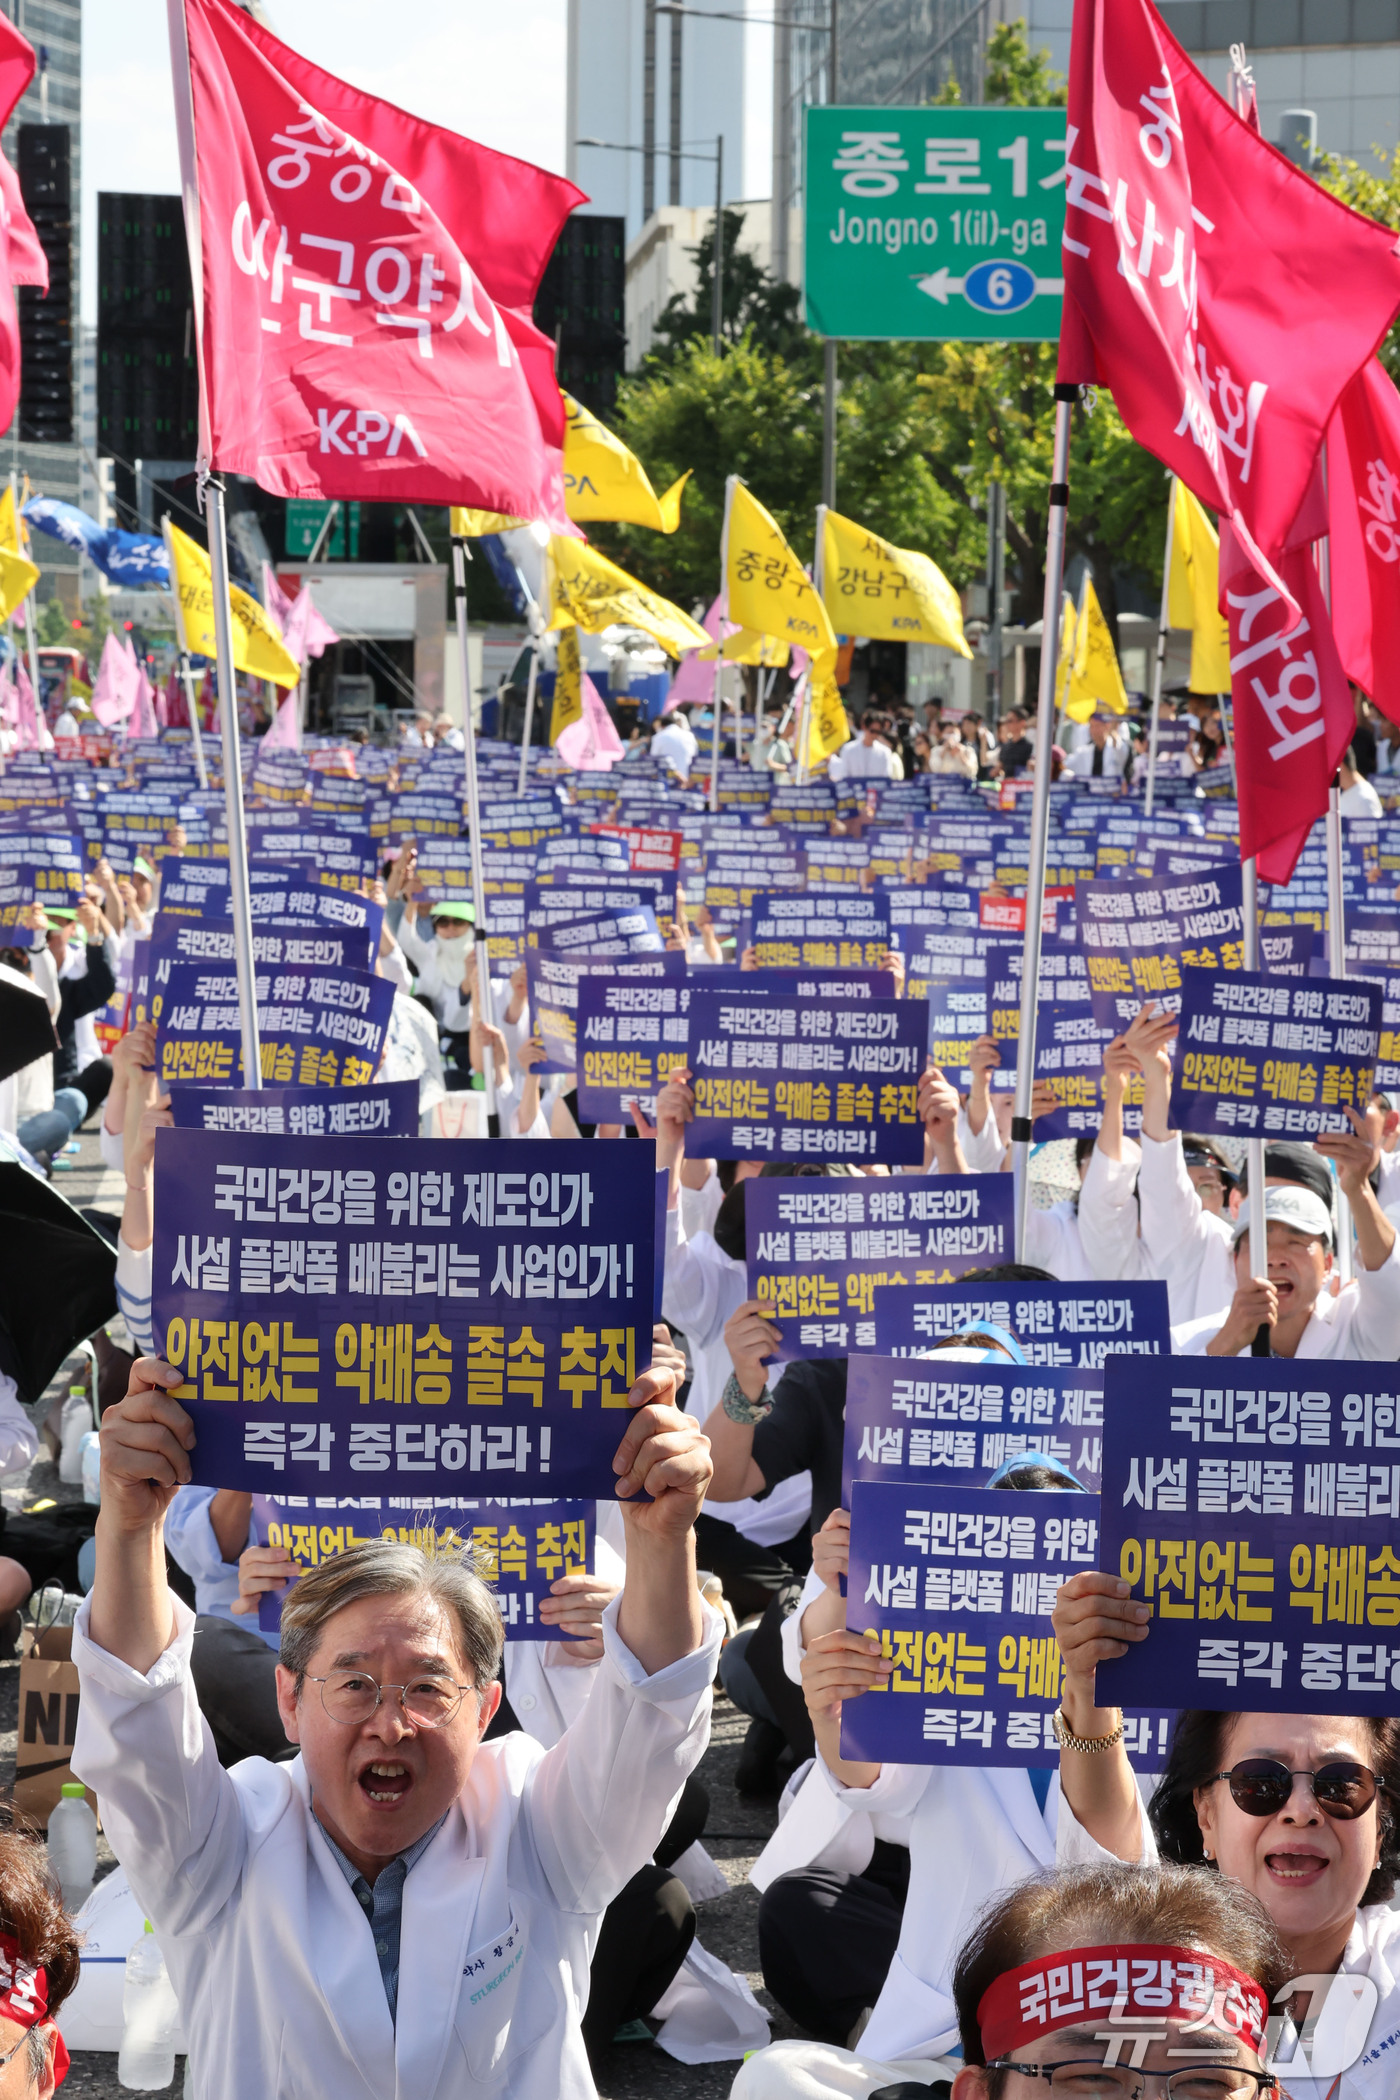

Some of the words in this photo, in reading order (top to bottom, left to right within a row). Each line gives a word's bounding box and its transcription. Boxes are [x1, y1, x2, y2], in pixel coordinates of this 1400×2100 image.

[830, 208, 938, 254] Jongno
[949, 209, 1048, 255] 1(il)-ga
[987, 268, 1013, 306] 6
[317, 408, 428, 457] KPA
[288, 892, 316, 914] 위한
[317, 896, 367, 927] 제도인가
[1087, 893, 1136, 917] 국민건강을
[1135, 892, 1162, 913] 위한
[1162, 882, 1221, 913] 제도인가
[284, 940, 343, 965] 제도인가
[1128, 920, 1182, 947] 배불리는
[1132, 953, 1182, 992] 약배송
[273, 976, 306, 1001] 위한
[307, 978, 370, 1013] 제도인가
[606, 988, 676, 1012] 국민건강을
[1213, 983, 1289, 1015] 국민건강을
[1293, 991, 1324, 1018] 위한
[1325, 994, 1370, 1022] 제도인가
[168, 1006, 200, 1030] 사설
[316, 1010, 382, 1053] 사업인가!
[585, 1017, 614, 1040] 사설
[617, 1017, 660, 1041] 플랫폼
[719, 1007, 796, 1036] 국민건강을
[801, 1011, 832, 1037] 위한
[835, 1012, 898, 1039] 제도인가
[1188, 1015, 1220, 1042] 사설
[1222, 1018, 1269, 1047] 플랫폼
[1272, 1023, 1332, 1052] 배불리는
[162, 1042, 233, 1080] 안전없는
[299, 1046, 338, 1087] 졸속
[584, 1052, 651, 1088] 안전없는
[697, 1040, 728, 1067] 사설
[732, 1041, 778, 1068] 플랫폼
[782, 1043, 844, 1070] 배불리는
[848, 1046, 917, 1072] 사업인가!
[1038, 1049, 1061, 1069] 사설
[1182, 1053, 1256, 1096] 안전없는
[1262, 1060, 1317, 1102] 약배송
[1321, 1065, 1354, 1105] 졸속
[289, 1105, 325, 1135] 위한
[329, 1099, 390, 1132] 제도인가
[695, 1079, 768, 1118] 안전없는
[775, 1081, 830, 1120] 약배송
[837, 1083, 873, 1122] 졸속
[880, 1083, 917, 1123] 추진
[1216, 1102, 1259, 1126] 즉각
[732, 1127, 776, 1150] 즉각
[781, 1128, 876, 1153] 중단하라!
[215, 1165, 376, 1224] 국민건강을
[387, 1171, 453, 1226] 위한
[463, 1173, 593, 1226] 제도인가
[779, 1193, 864, 1223] 국민건강을
[869, 1192, 905, 1221] 위한
[909, 1190, 980, 1220] 제도인가
[757, 1232, 790, 1261] 사설
[795, 1231, 846, 1261] 플랫폼
[851, 1229, 921, 1259] 배불리는
[926, 1226, 1003, 1256] 사업인가!
[172, 1235, 230, 1291] 사설
[240, 1239, 337, 1294] 플랫폼
[349, 1242, 480, 1297] 배불리는
[491, 1244, 633, 1298] 사업인가!
[757, 1275, 839, 1320] 안전없는
[800, 1323, 849, 1347] 즉각
[1016, 1301, 1054, 1335] 위한
[1059, 1300, 1133, 1332] 제도인가
[165, 1318, 319, 1402] 안전없는
[335, 1323, 452, 1404] 약배송
[467, 1326, 544, 1407] 졸속
[559, 1326, 637, 1408] 추진
[892, 1380, 1003, 1422] 국민건강을
[1010, 1387, 1055, 1424] 위한
[1060, 1390, 1104, 1426] 제도
[1170, 1388, 1331, 1445] 국민건강을
[1342, 1394, 1400, 1447] 위한
[244, 1422, 335, 1471] 즉각
[349, 1425, 551, 1472] 중단하라!
[858, 1427, 903, 1464] 사설
[909, 1429, 976, 1468] 플랫폼
[1123, 1457, 1187, 1511] 사설
[1198, 1459, 1293, 1514] 플랫폼
[1304, 1463, 1400, 1518] 배불리
[537, 1520, 587, 1581] 추진
[905, 1511, 1035, 1559] 국민건강을
[1044, 1519, 1098, 1561] 위한
[864, 1565, 917, 1610] 사설
[925, 1568, 1003, 1613] 플랫폼
[1119, 1539, 1274, 1621] 안전없는
[1290, 1544, 1400, 1625] 약배송
[1198, 1640, 1287, 1688] 즉각
[923, 1709, 996, 1747] 즉각
